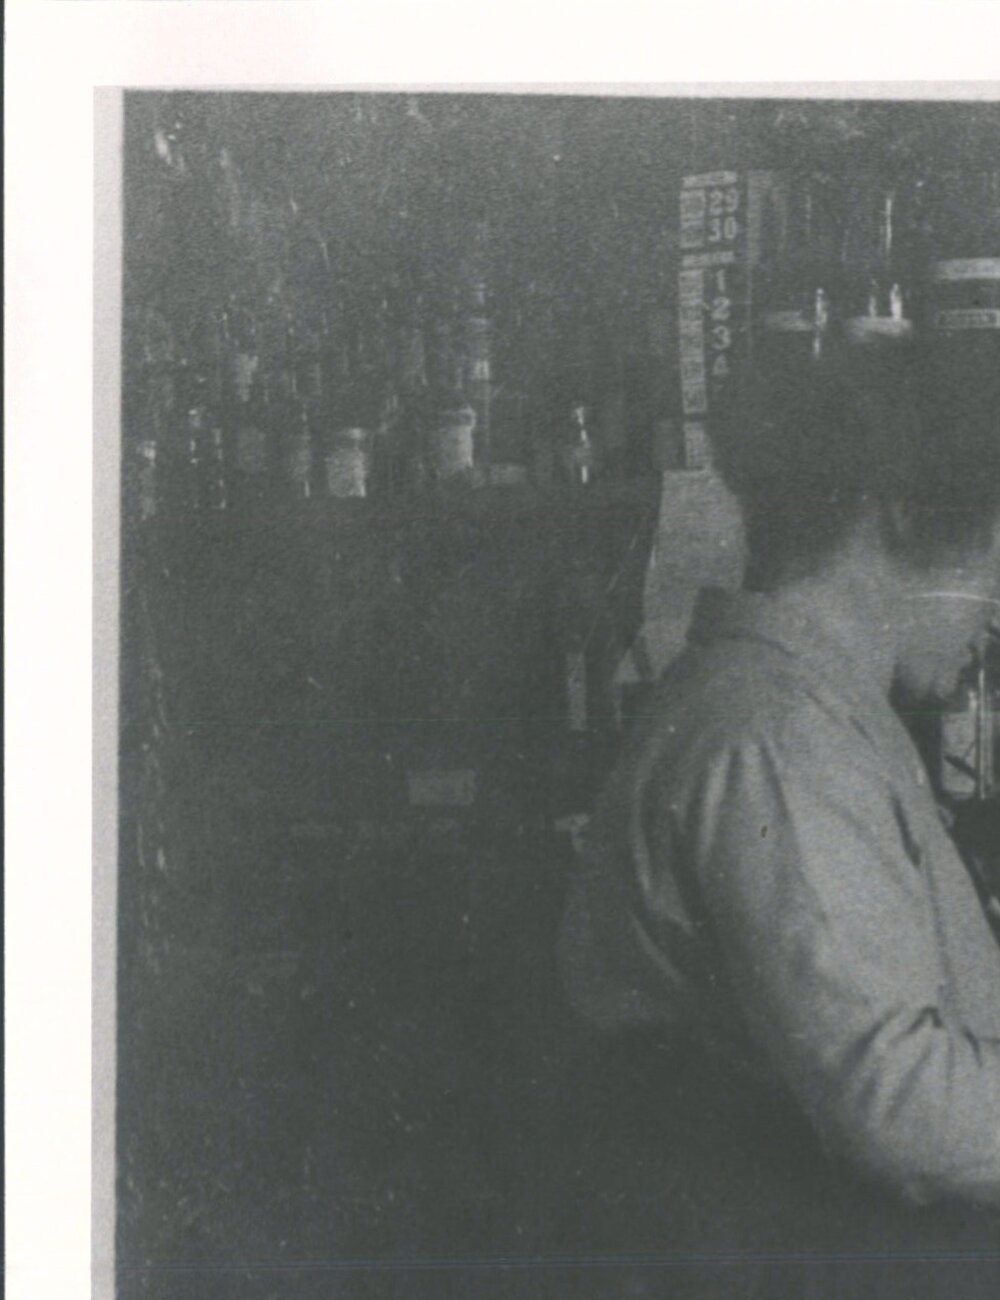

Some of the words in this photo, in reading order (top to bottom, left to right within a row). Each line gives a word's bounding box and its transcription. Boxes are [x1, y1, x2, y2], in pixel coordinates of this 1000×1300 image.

[707, 216, 739, 243] 30
[711, 296, 732, 321] 2
[711, 325, 732, 350] 3
